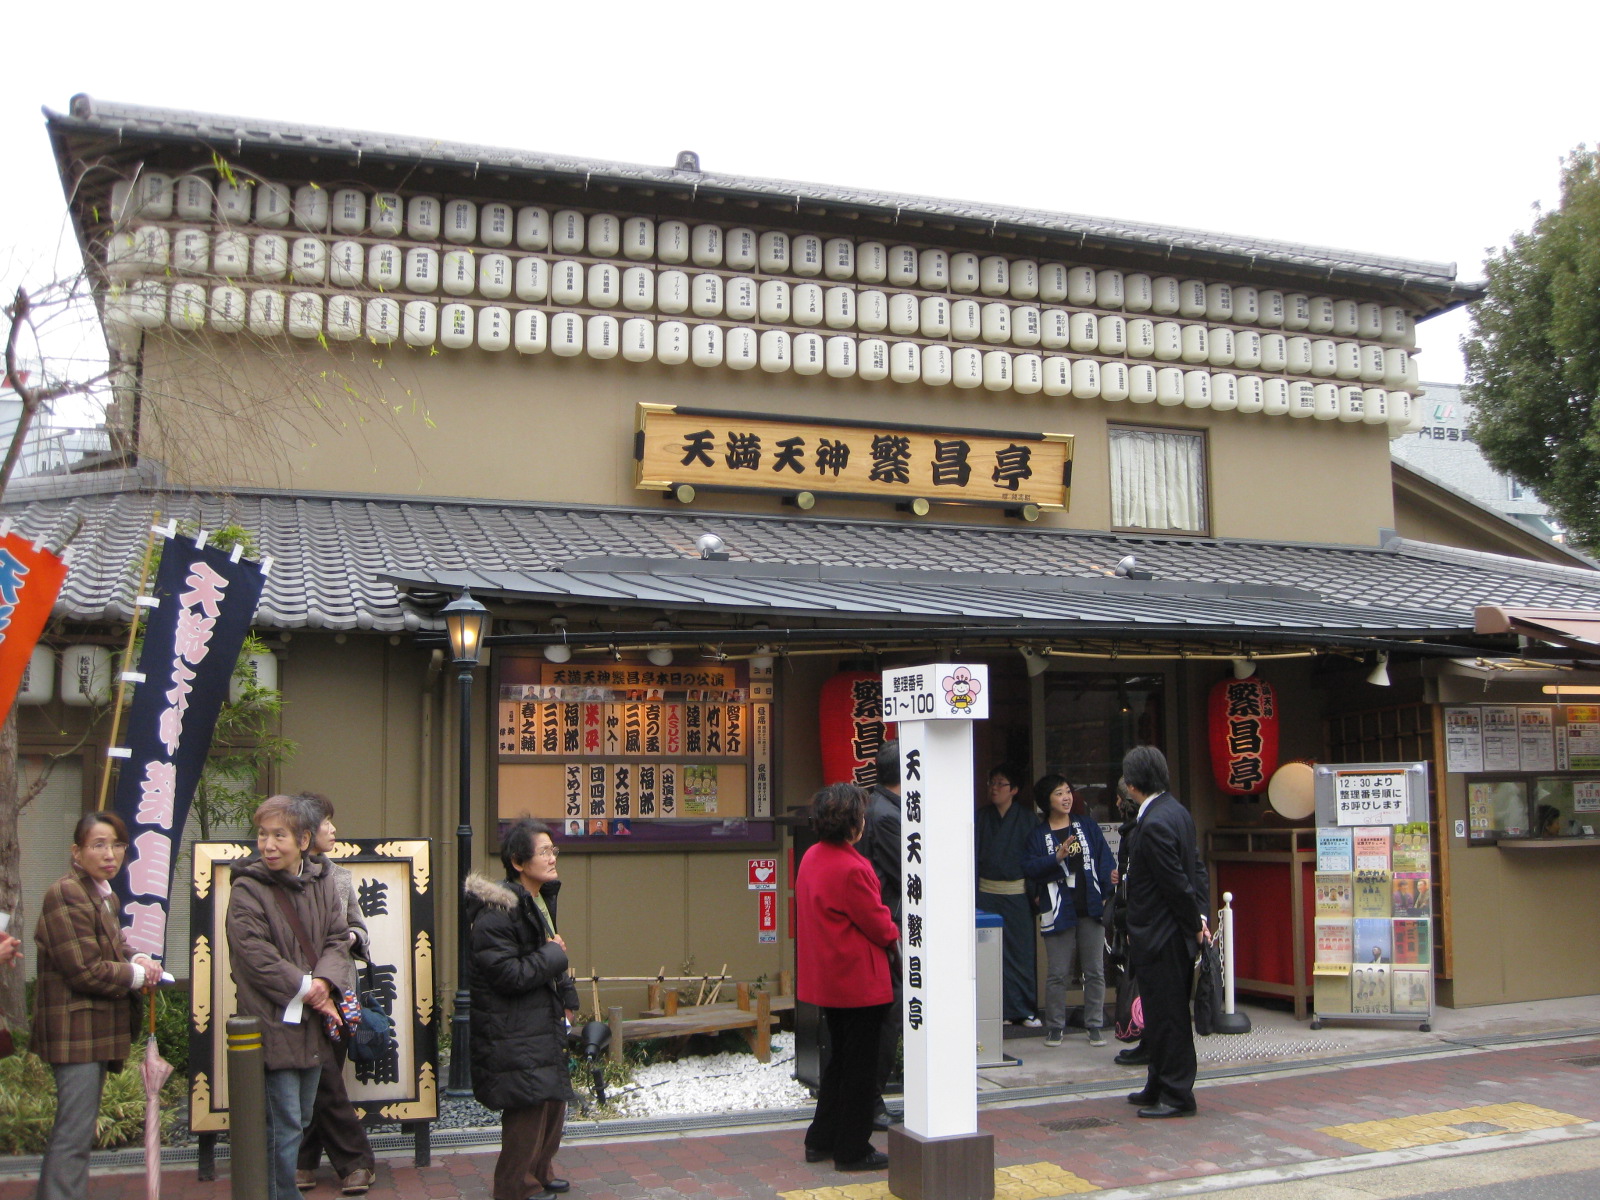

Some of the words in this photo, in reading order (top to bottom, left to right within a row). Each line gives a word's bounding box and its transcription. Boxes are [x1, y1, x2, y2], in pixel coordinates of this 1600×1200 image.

[494, 259, 502, 284] 天下一品
[681, 429, 1033, 491] 天満天神繁昌亭
[553, 669, 725, 687] 天満天神繁昌亭本日の公演
[893, 674, 924, 693] 整理番号
[521, 702, 536, 752] 春之輔
[564, 703, 579, 752] 福郎
[668, 704, 680, 753] TASUKU
[707, 705, 722, 753] 竹丸
[1226, 682, 1263, 791] 繁昌亭
[567, 766, 580, 815] そめすけ
[590, 766, 605, 815] 団四郎
[615, 767, 629, 815] 文福
[640, 767, 654, 815] 福郎
[1340, 789, 1402, 799] 整理番号順に
[1341, 800, 1402, 811] お呼びします
[751, 860, 774, 868] AED
[358, 878, 389, 918] 桂
[905, 749, 923, 1030] 天満天神繁昌亭
